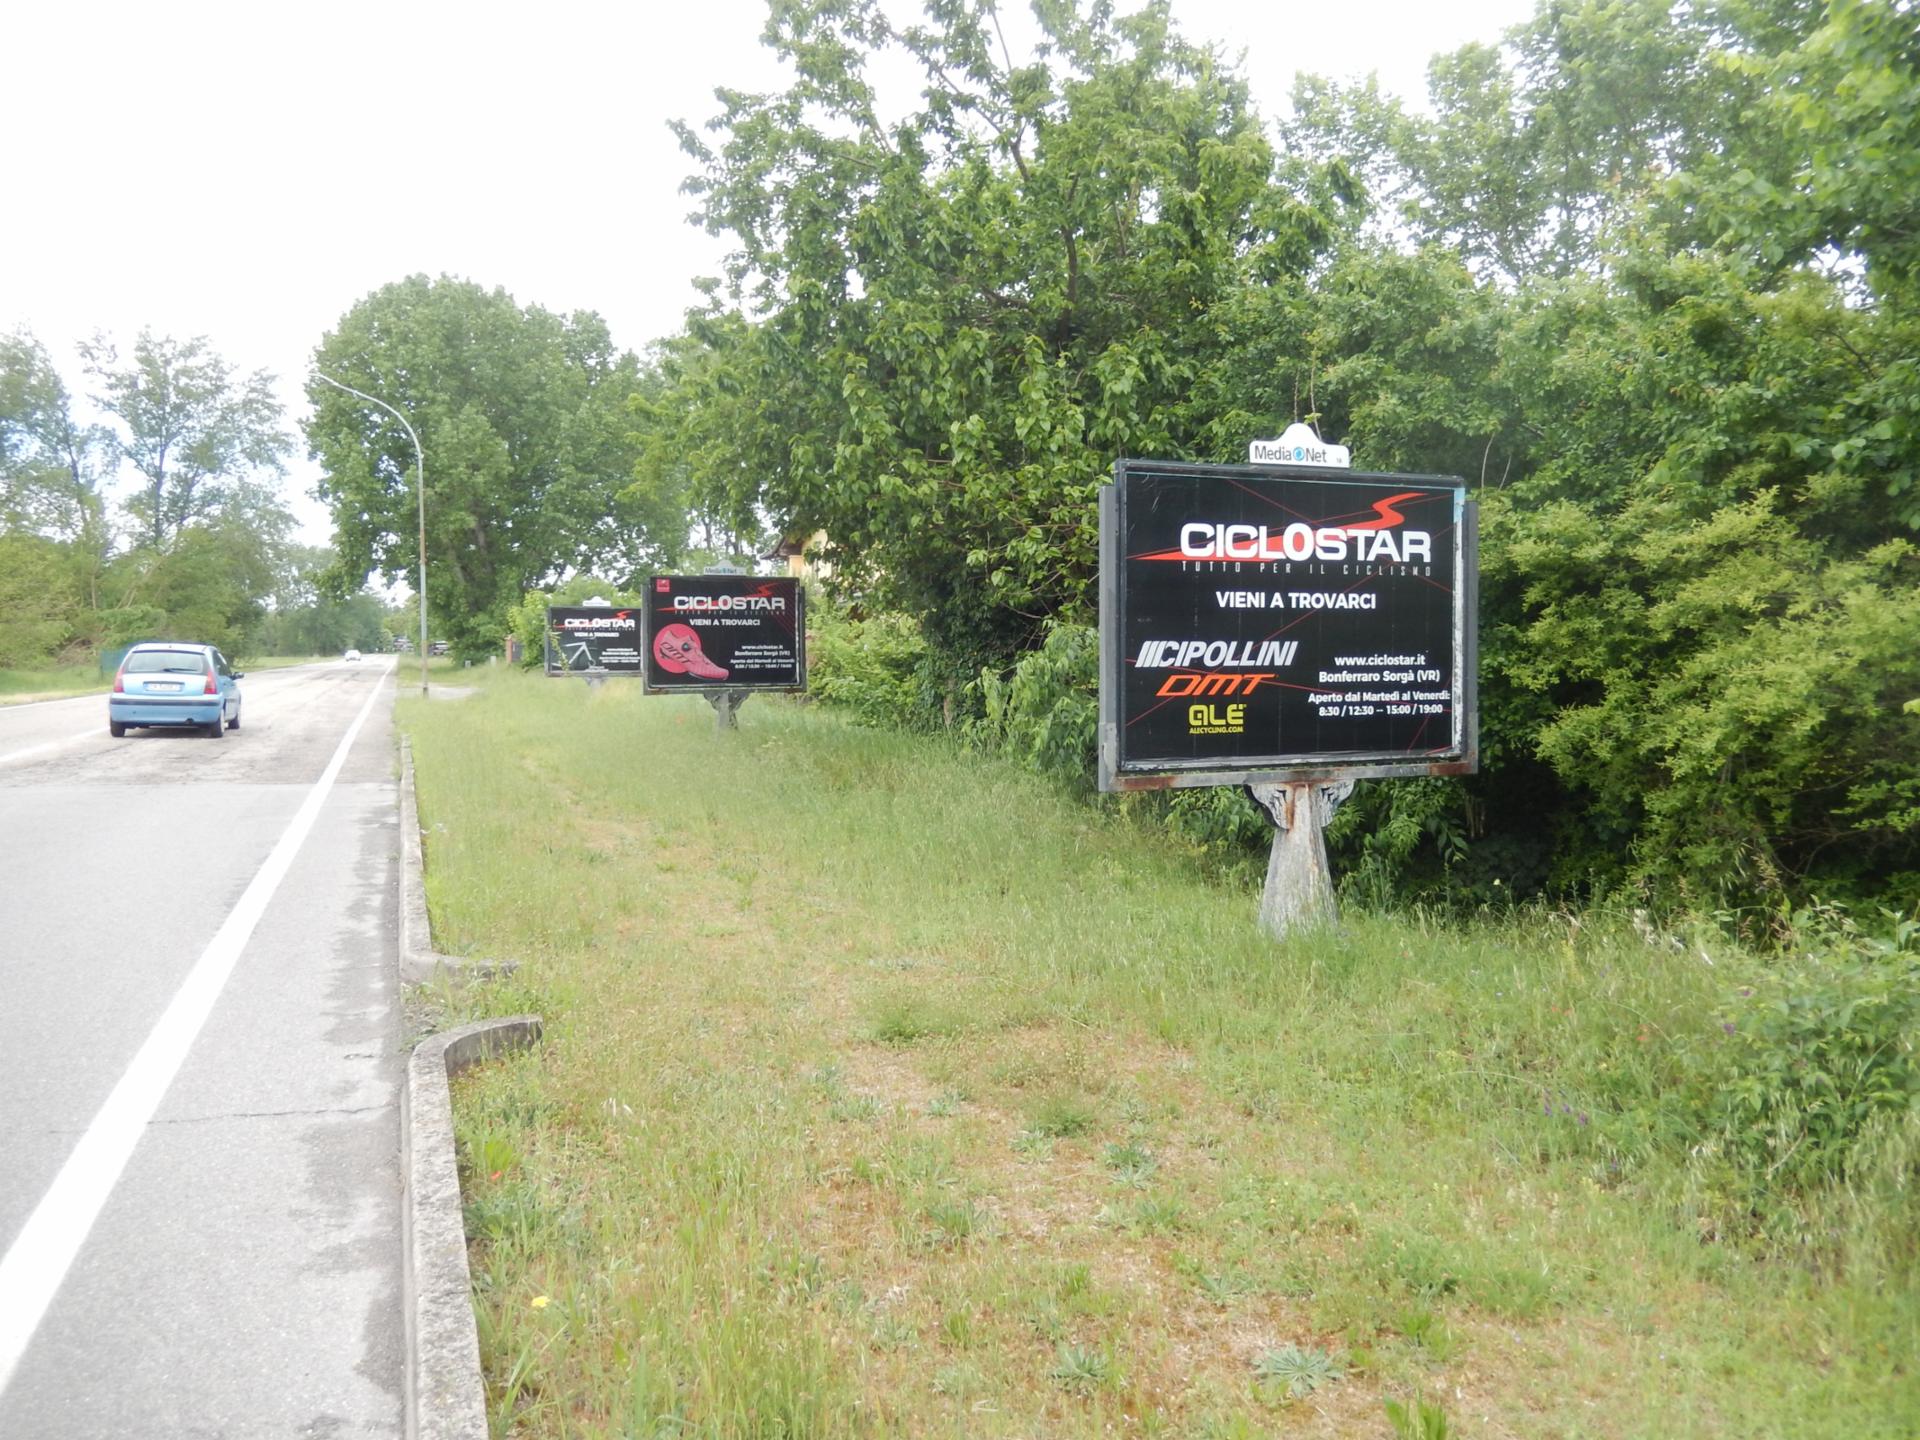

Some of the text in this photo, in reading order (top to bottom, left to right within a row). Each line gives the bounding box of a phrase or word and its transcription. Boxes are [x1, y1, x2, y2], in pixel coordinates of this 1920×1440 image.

[1254, 445, 1327, 463] Media Net
[1180, 523, 1432, 562] CICLOSTAR
[1182, 561, 1431, 577] TUTTO PER IL CICLISMO
[673, 595, 785, 610] CICLOSTAR
[1216, 591, 1376, 609] VIENI A TROVARCI
[564, 618, 635, 628] CICLOSTAR
[1334, 654, 1426, 666] www.ciclostar.it
[1319, 669, 1440, 683] Bonferraro Sorgà (VR)
[1308, 693, 1345, 704] Aperto
[1345, 692, 1361, 702] dal
[1362, 691, 1400, 701] Martedì
[1402, 691, 1411, 701] al
[1319, 707, 1340, 716] 8:30
[1349, 706, 1374, 716] 12:30
[1386, 705, 1411, 715] 15:00
[1419, 704, 1443, 714] 19:00
